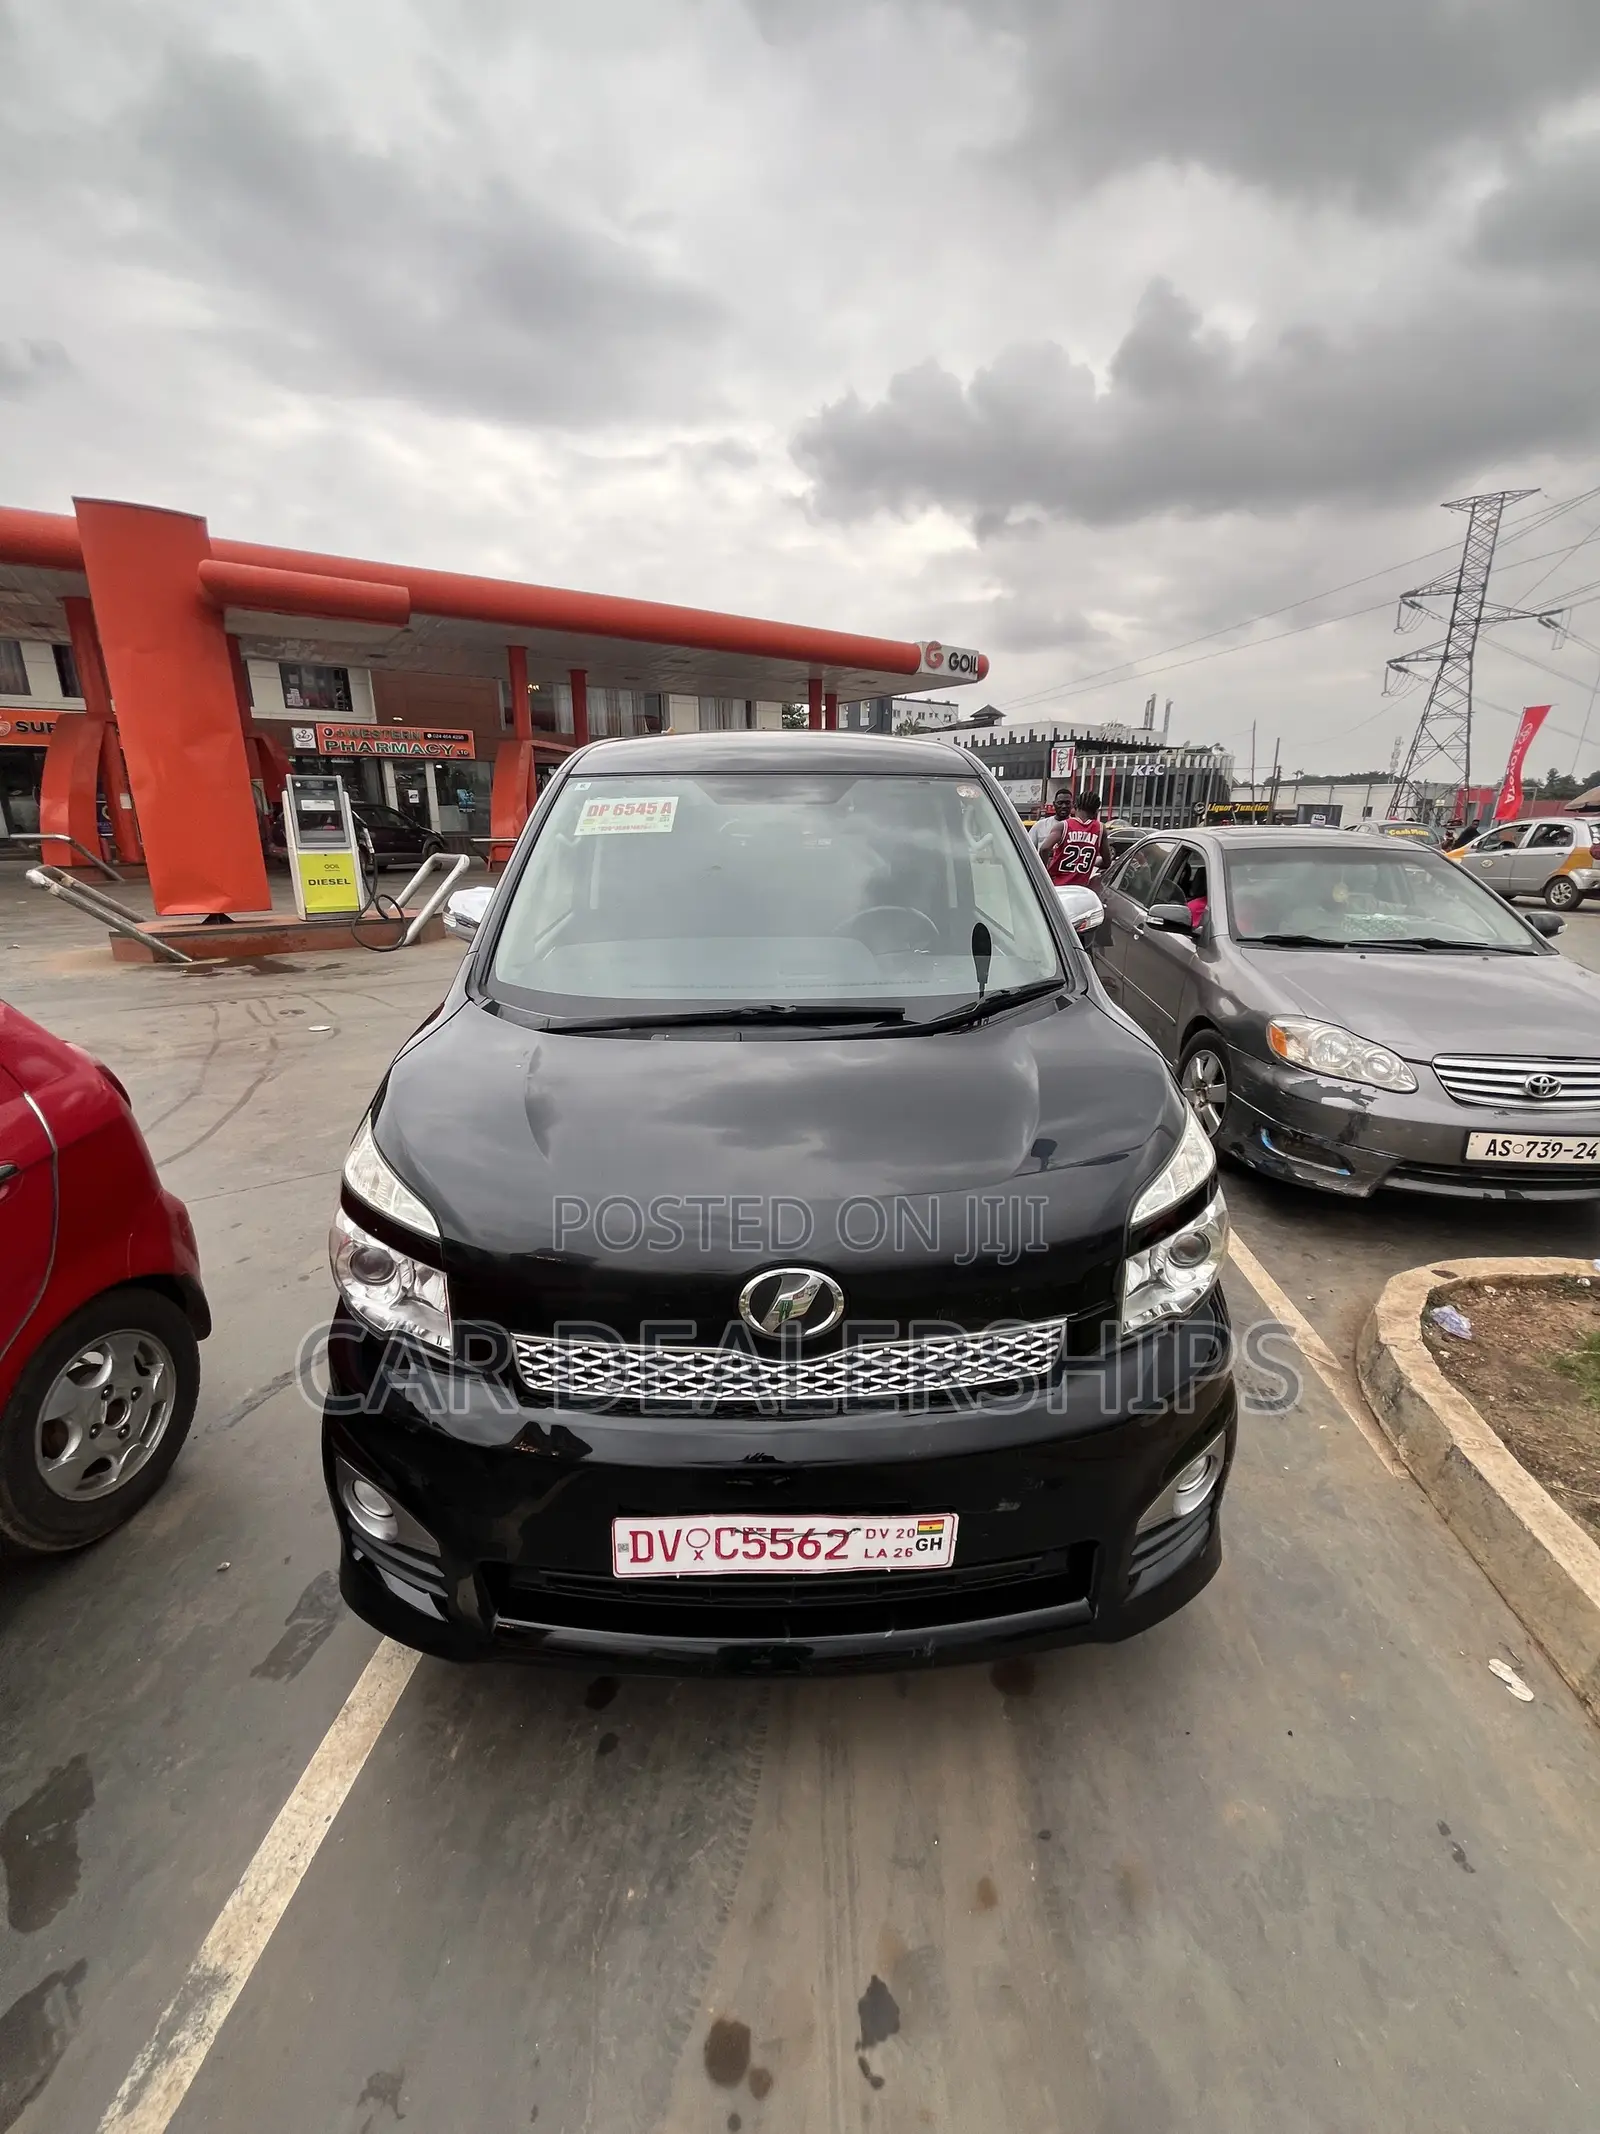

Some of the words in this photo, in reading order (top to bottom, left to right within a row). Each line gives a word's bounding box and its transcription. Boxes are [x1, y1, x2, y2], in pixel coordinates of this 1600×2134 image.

[949, 652, 978, 674] GOIL
[345, 727, 421, 741] WESTERN
[324, 740, 455, 756] PHARMACY
[1131, 764, 1166, 776] KFC
[1503, 747, 1521, 804] TOYOTA
[613, 802, 658, 816] 6545
[660, 801, 672, 814] A
[1207, 803, 1232, 813] Liquor
[1067, 831, 1098, 845] JORDAN
[1059, 845, 1096, 873] 23
[308, 878, 351, 886] DIESEL
[1485, 1138, 1513, 1156] AS
[1525, 1141, 1599, 1159] 739-24
[865, 1528, 890, 1540] DV
[896, 1527, 916, 1539] 20
[629, 1529, 683, 1563] DV
[915, 1537, 943, 1552] GH
[864, 1548, 888, 1559] LA
[892, 1547, 914, 1559] 26
